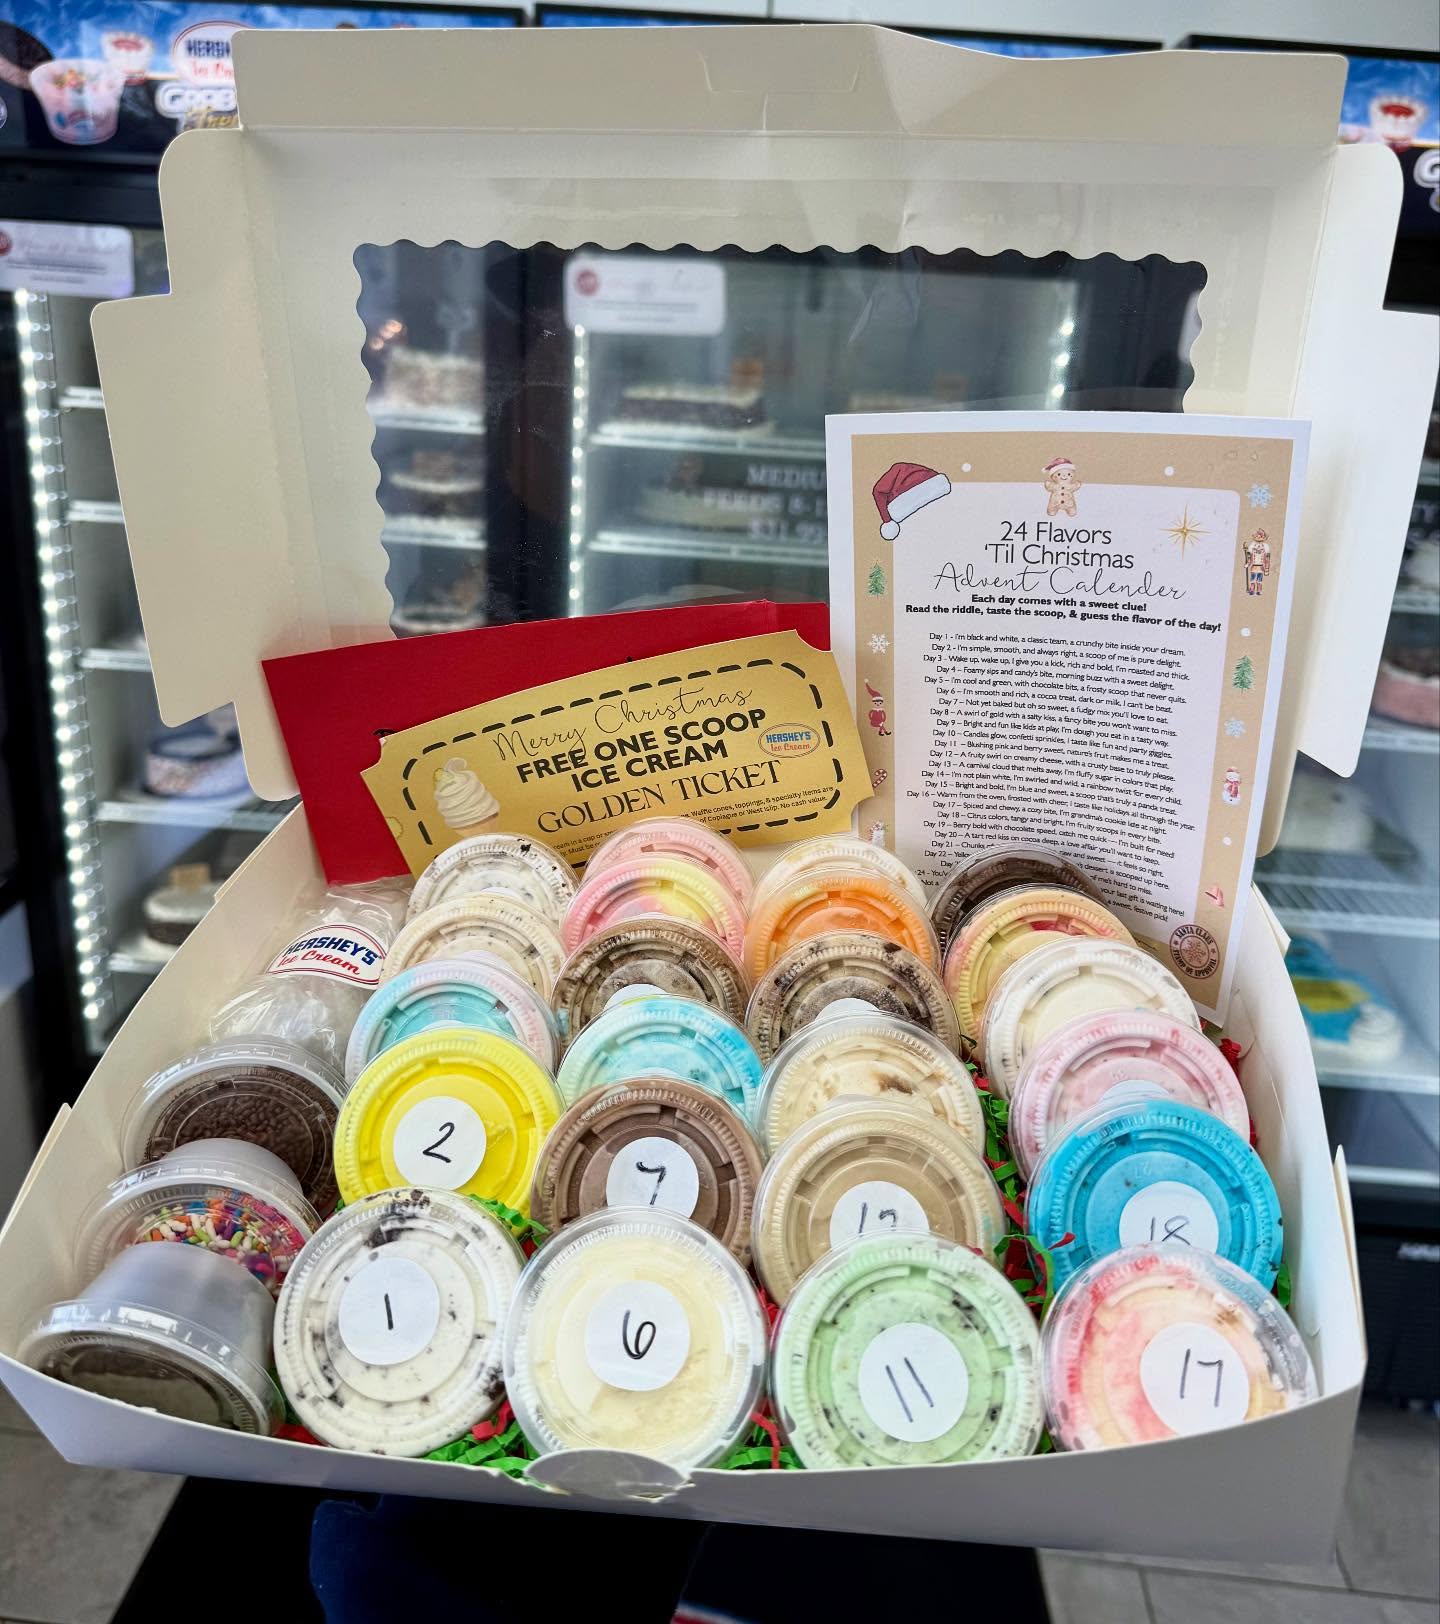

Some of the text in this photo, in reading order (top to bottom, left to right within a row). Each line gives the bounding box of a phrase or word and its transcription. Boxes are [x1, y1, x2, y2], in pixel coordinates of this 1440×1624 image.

[747, 464, 826, 490] MEDIU
[1000, 521, 1112, 545] 24 Flavors
[1022, 543, 1134, 569] Christmas
[934, 562, 1187, 600] Advent Calender
[971, 594, 995, 605] Each
[998, 595, 1016, 607] day
[1018, 598, 1051, 606] comes
[1054, 597, 1077, 607] with
[1088, 600, 1119, 609] sweet
[1121, 601, 1147, 613] clue!
[906, 604, 1221, 634] Read the riddle, taste the scoop, & guess the flavor of the day!
[929, 632, 942, 641] Day
[999, 635, 1019, 643] white,
[1075, 640, 1103, 649] crunchy
[1105, 641, 1118, 649] bite
[1120, 642, 1140, 651] inside
[1160, 647, 1185, 656] dream.
[931, 643, 945, 652] Day
[969, 645, 991, 653] simple,
[1036, 648, 1058, 657] always
[1060, 649, 1077, 658] right,
[1085, 652, 1106, 660] scoop
[1137, 657, 1154, 665] pure
[1156, 658, 1181, 668] delight.
[936, 665, 949, 674] Day
[963, 666, 985, 675] Foamy
[986, 668, 999, 676] sips
[1014, 669, 1037, 678] candy's
[1039, 670, 1053, 678] bite,
[1055, 672, 1084, 682] morning
[1086, 674, 1102, 682] buzz
[1103, 676, 1119, 684] with
[1149, 680, 1174, 691] delight.
[492, 686, 753, 764] Merry Christmas
[766, 731, 811, 743] HERSHEY'S
[516, 708, 766, 784] FREE ONE SCOOP
[783, 743, 811, 751] Cream
[571, 739, 729, 793] ICE CREAM
[537, 760, 782, 833] GOLDEN TICKET
[282, 936, 378, 966] HERSHEY'S
[1175, 927, 1214, 945] SANTA CLAUS
[278, 949, 360, 975] Ice Cream
[422, 1121, 455, 1164] 2
[1149, 1214, 1193, 1246] 18
[383, 1293, 394, 1331] 1
[622, 1309, 657, 1360] 6
[885, 1357, 934, 1422] 11
[1179, 1348, 1224, 1408] 17
